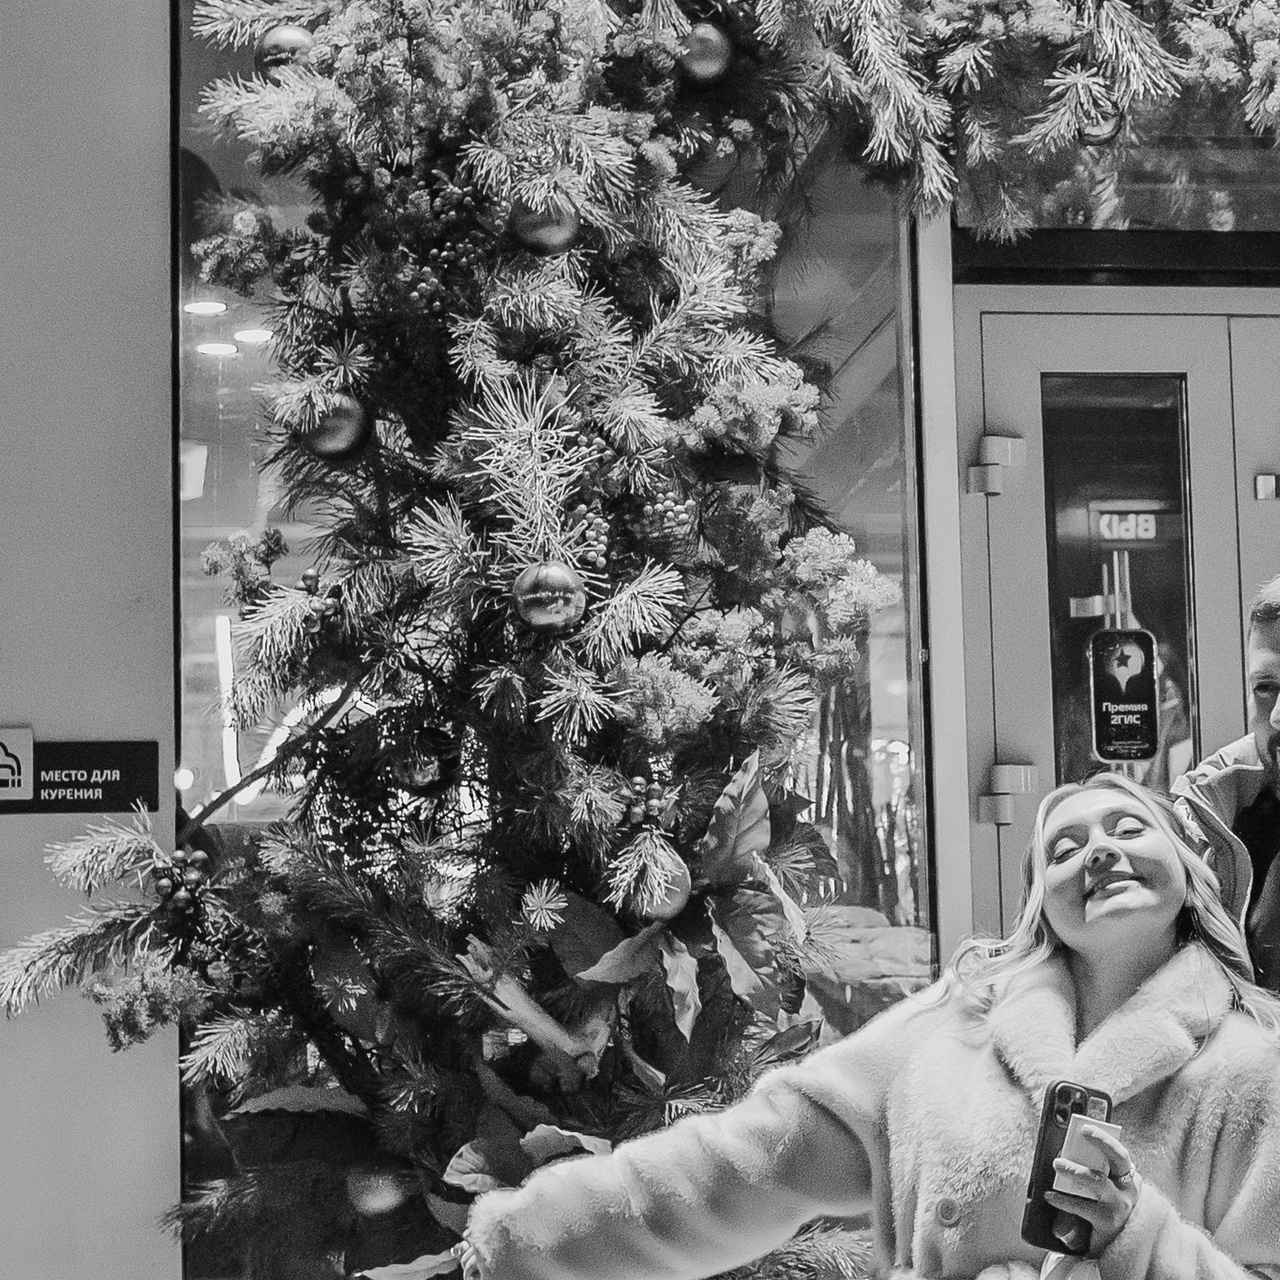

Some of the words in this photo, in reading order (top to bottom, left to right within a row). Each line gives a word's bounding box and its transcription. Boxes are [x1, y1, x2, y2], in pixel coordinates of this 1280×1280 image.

[1102, 701, 1149, 714] Премия
[1110, 715, 1141, 725] 2ГИС
[40, 770, 88, 782] МЕСТО
[90, 769, 121, 783] ДЛЯ
[40, 788, 103, 800] КУРЕНИЯ
